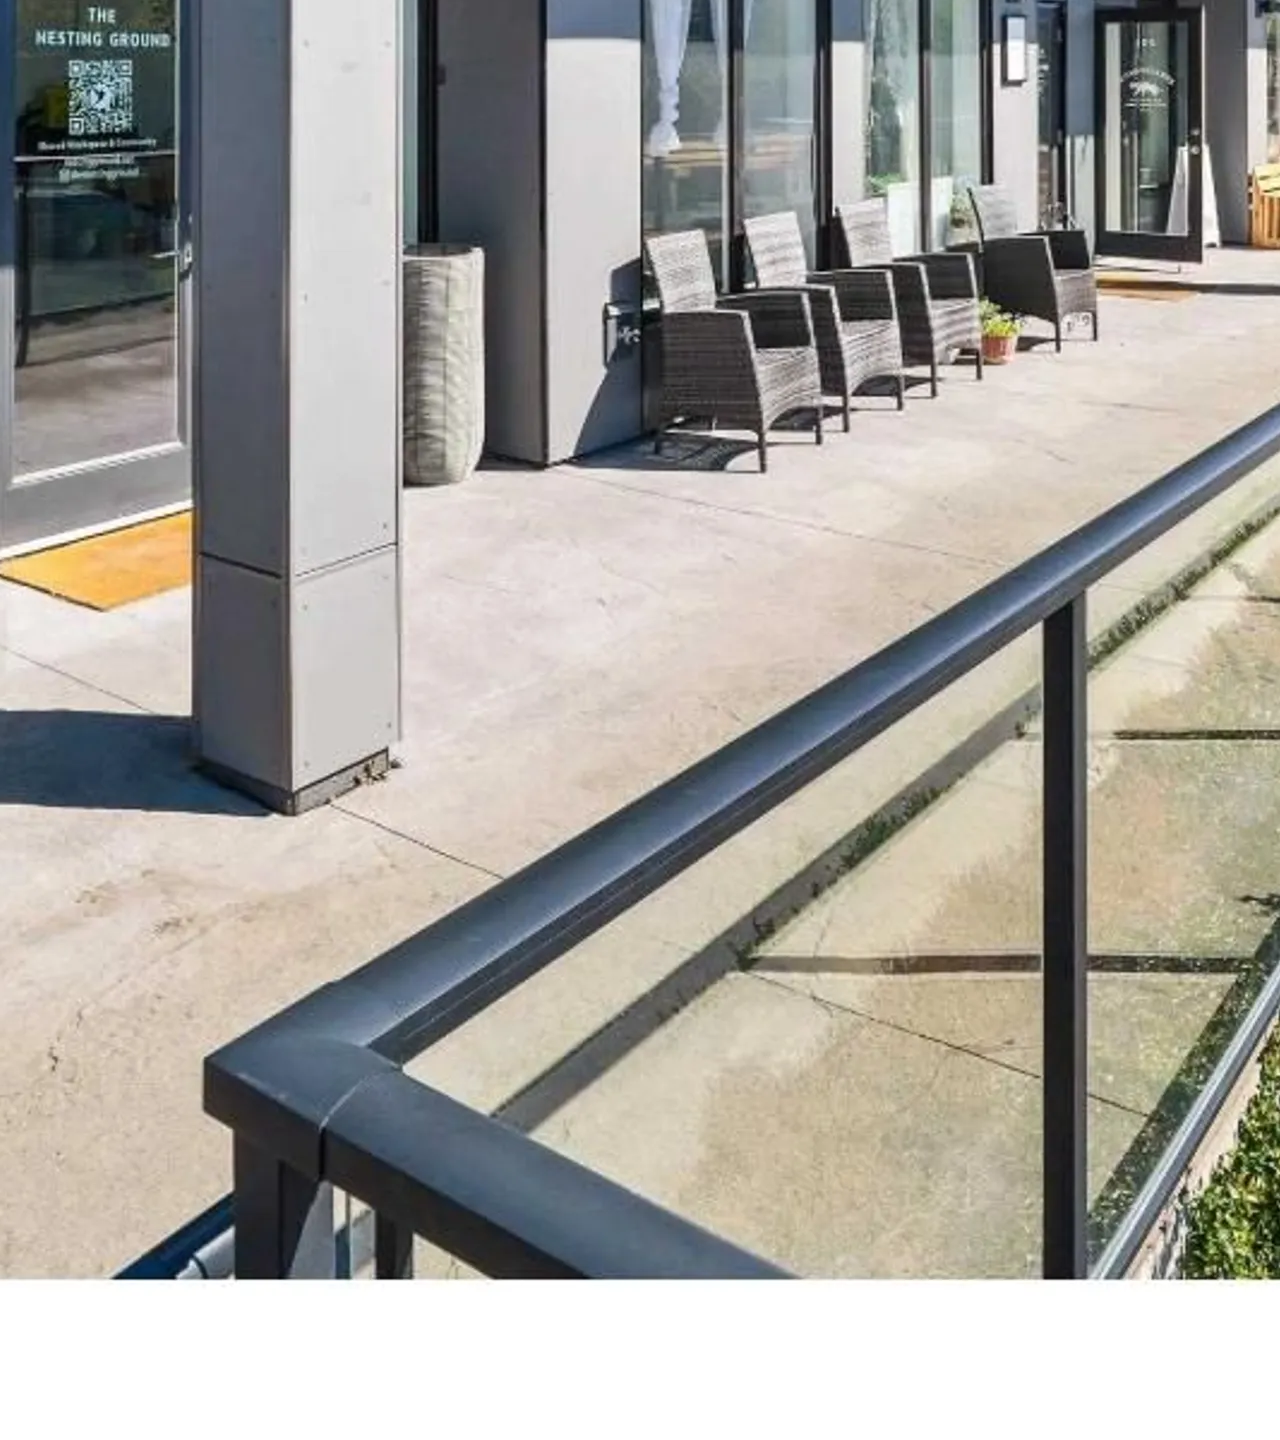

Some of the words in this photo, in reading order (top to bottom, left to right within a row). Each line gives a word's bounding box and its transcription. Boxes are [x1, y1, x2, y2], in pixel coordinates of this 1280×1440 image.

[87, 7, 117, 24] THE
[35, 29, 103, 47] NESTING
[109, 32, 171, 48] GROUND
